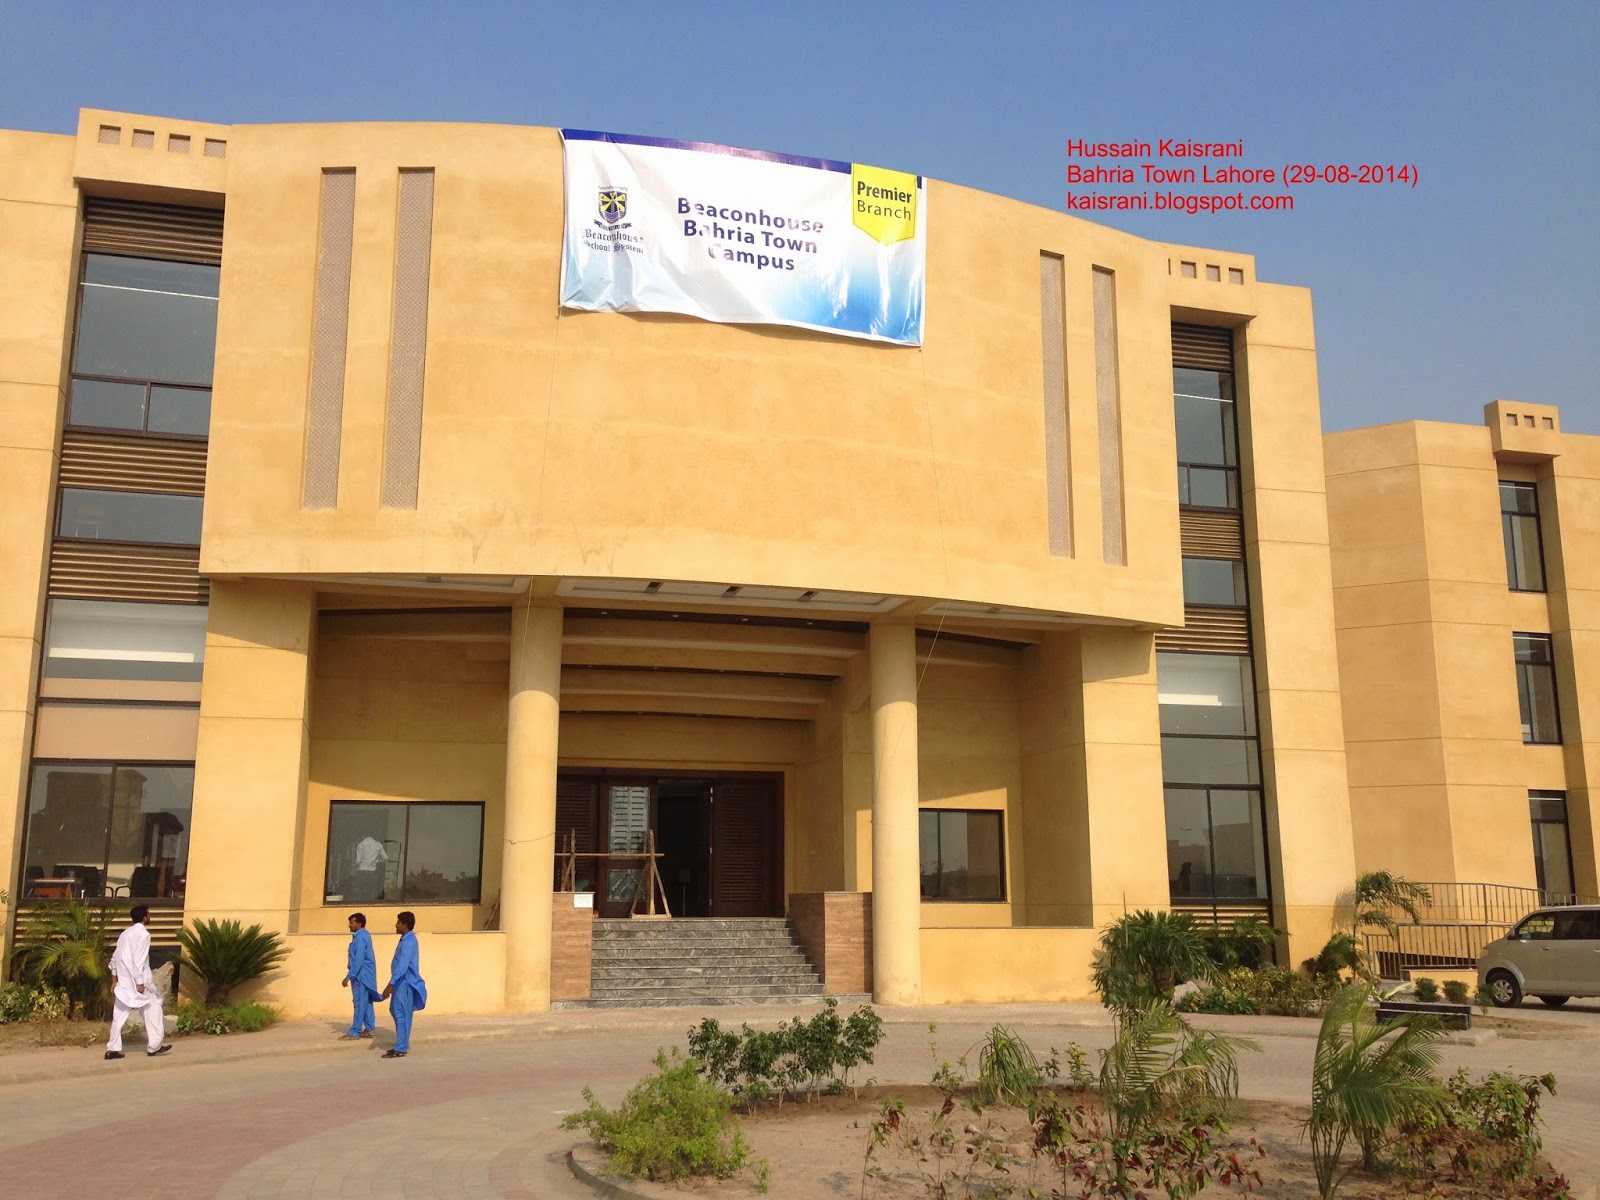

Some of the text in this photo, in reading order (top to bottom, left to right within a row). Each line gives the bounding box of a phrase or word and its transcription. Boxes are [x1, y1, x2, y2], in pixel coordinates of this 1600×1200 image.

[857, 180, 912, 204] Premier
[677, 197, 824, 234] Beaconhouse
[857, 199, 912, 221] Branch
[761, 231, 818, 254] Town
[708, 243, 795, 271] Campus
